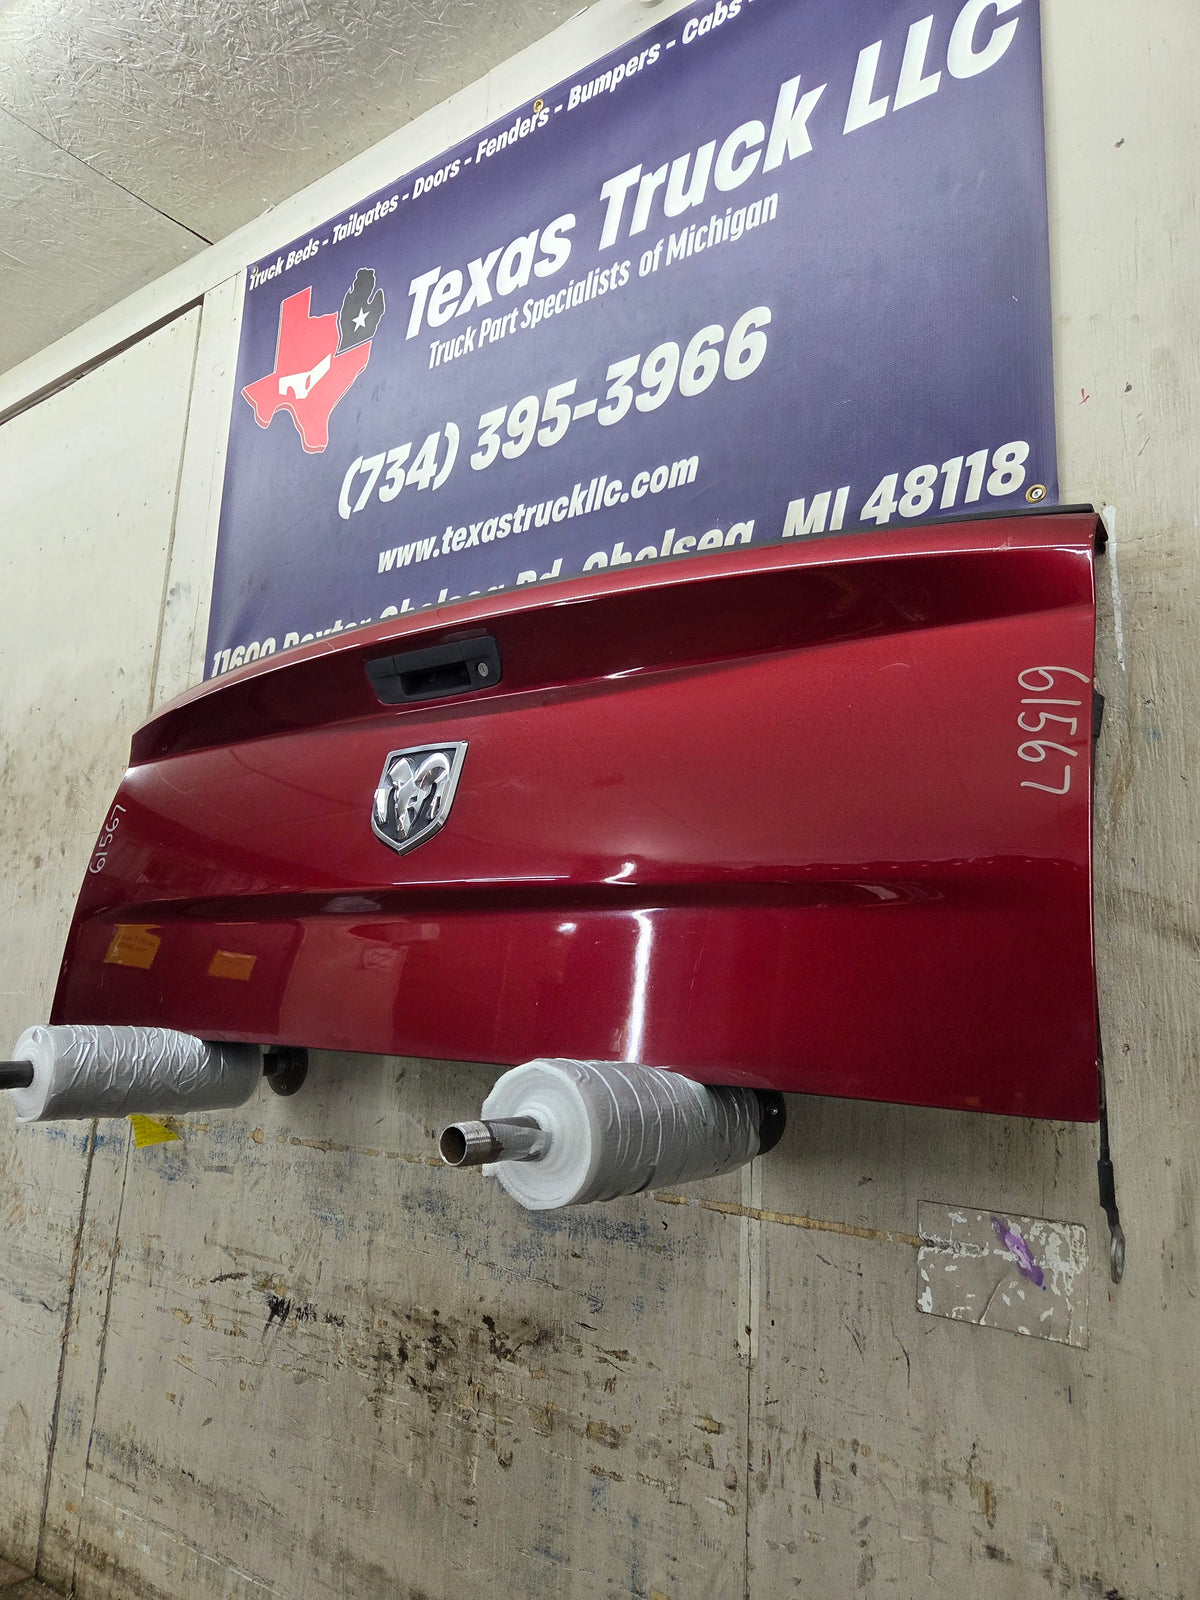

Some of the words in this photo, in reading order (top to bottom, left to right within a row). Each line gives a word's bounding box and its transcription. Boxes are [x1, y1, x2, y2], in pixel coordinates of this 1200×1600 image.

[248, 256, 285, 291] Truck
[284, 237, 320, 271] Beds
[332, 194, 399, 245] Tailgates
[411, 158, 461, 200] Doors
[475, 104, 550, 164] Fenders
[566, 43, 661, 112] Bumpers
[681, 0, 743, 45] Cabs
[404, 212, 577, 342] Texas
[597, 74, 828, 252] Truck
[842, 0, 1023, 136] LLC
[427, 324, 478, 371] Truck
[477, 306, 520, 350] Part
[519, 259, 632, 330] Specialists
[638, 237, 665, 278] of
[664, 192, 779, 267] Michigan
[338, 421, 460, 520] (734)
[469, 305, 772, 471] 395-3966
[377, 455, 700, 574] www.texastruckllc.com
[781, 485, 851, 538] MI
[1017, 665, 1091, 795] 61567
[88, 803, 127, 874] 61567
